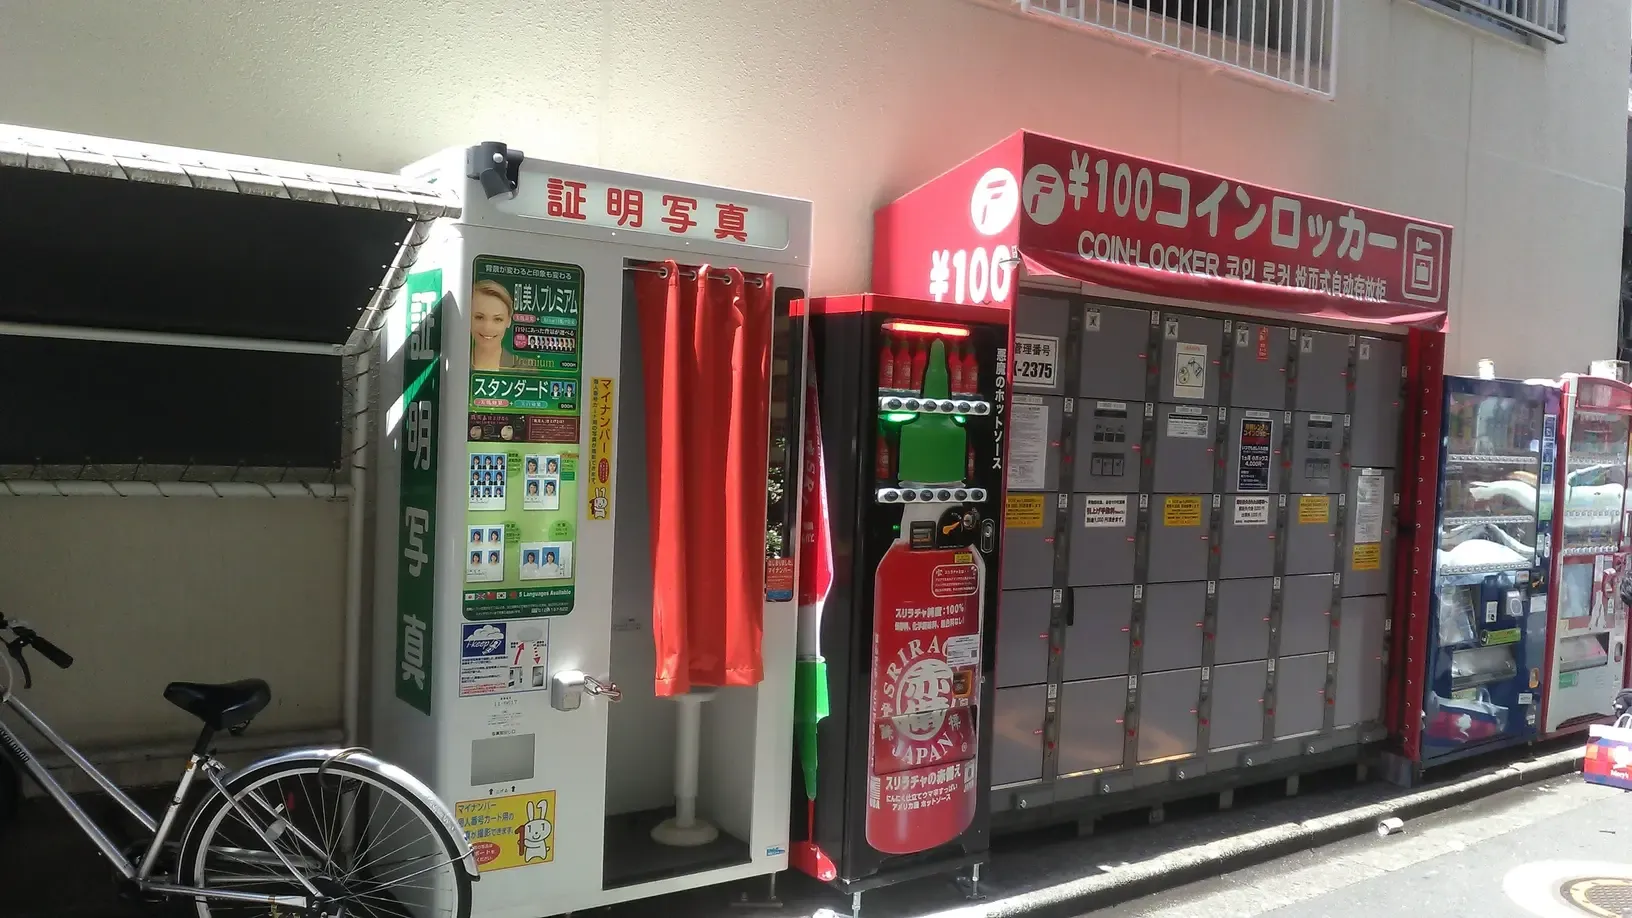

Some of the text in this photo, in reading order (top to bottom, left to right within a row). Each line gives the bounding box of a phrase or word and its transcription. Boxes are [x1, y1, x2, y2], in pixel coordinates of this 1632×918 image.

[547, 178, 748, 243] 証明写真
[1068, 150, 1398, 262] ¥100コインロッカー
[485, 264, 572, 280] 背景が変わると印象も変わる
[929, 245, 1012, 304] ¥100
[1078, 230, 1219, 277] COIN-LOCKER
[514, 283, 578, 315] 肌美人プレミアム
[513, 355, 556, 368] Premium
[474, 378, 549, 399] スタンダード
[992, 348, 1007, 470] 悪魔のホットソース
[599, 379, 612, 453] マイナンバー
[402, 292, 435, 691] 証明写真
[891, 732, 955, 766] JAPAN
[458, 803, 497, 813] マイナンバー
